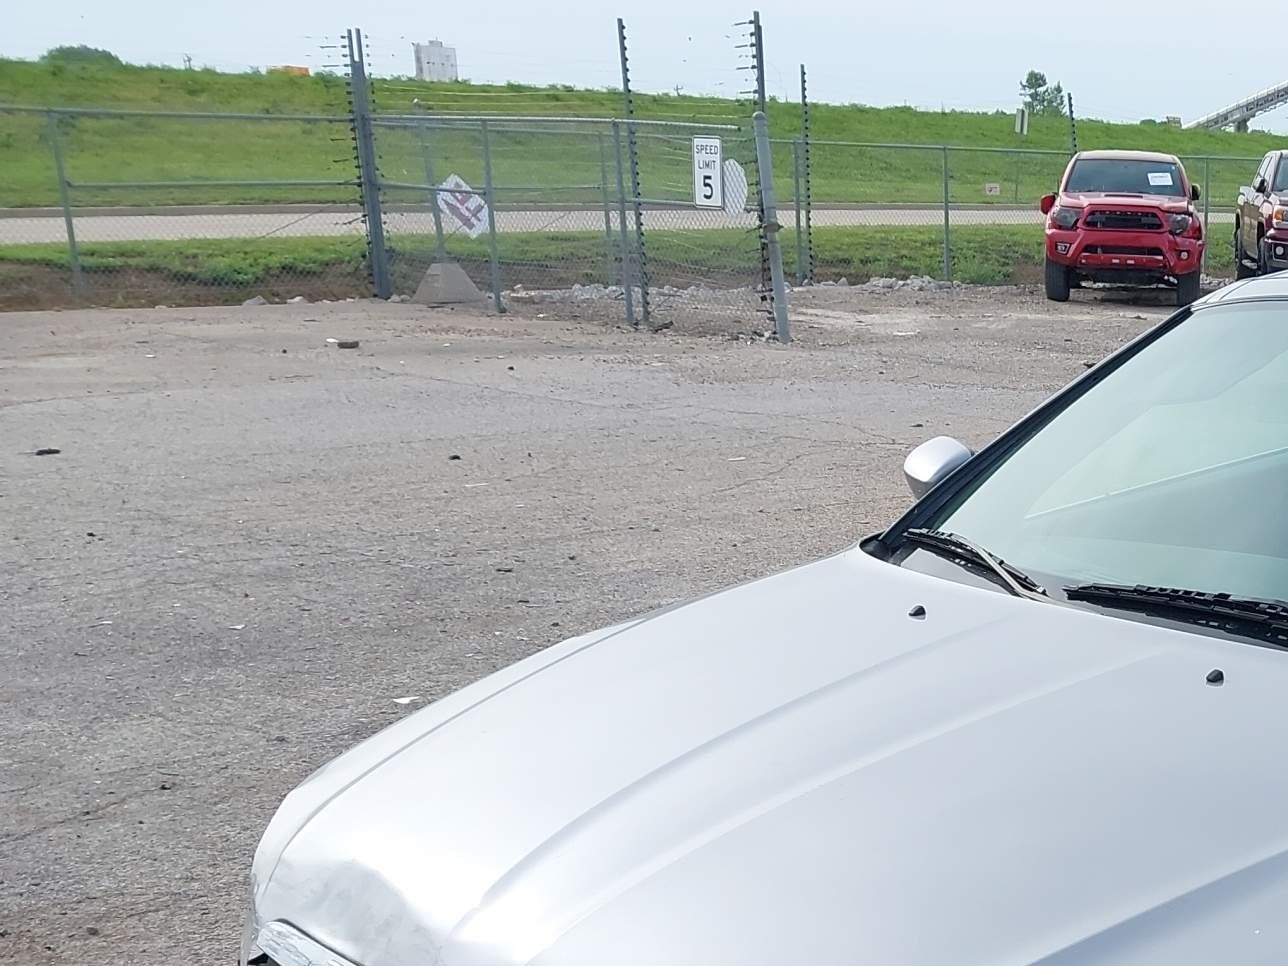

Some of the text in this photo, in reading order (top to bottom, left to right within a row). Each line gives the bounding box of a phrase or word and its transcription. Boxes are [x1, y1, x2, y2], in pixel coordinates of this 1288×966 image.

[695, 144, 719, 155] SPEED
[698, 159, 717, 170] LIMIT
[703, 175, 713, 200] 5
